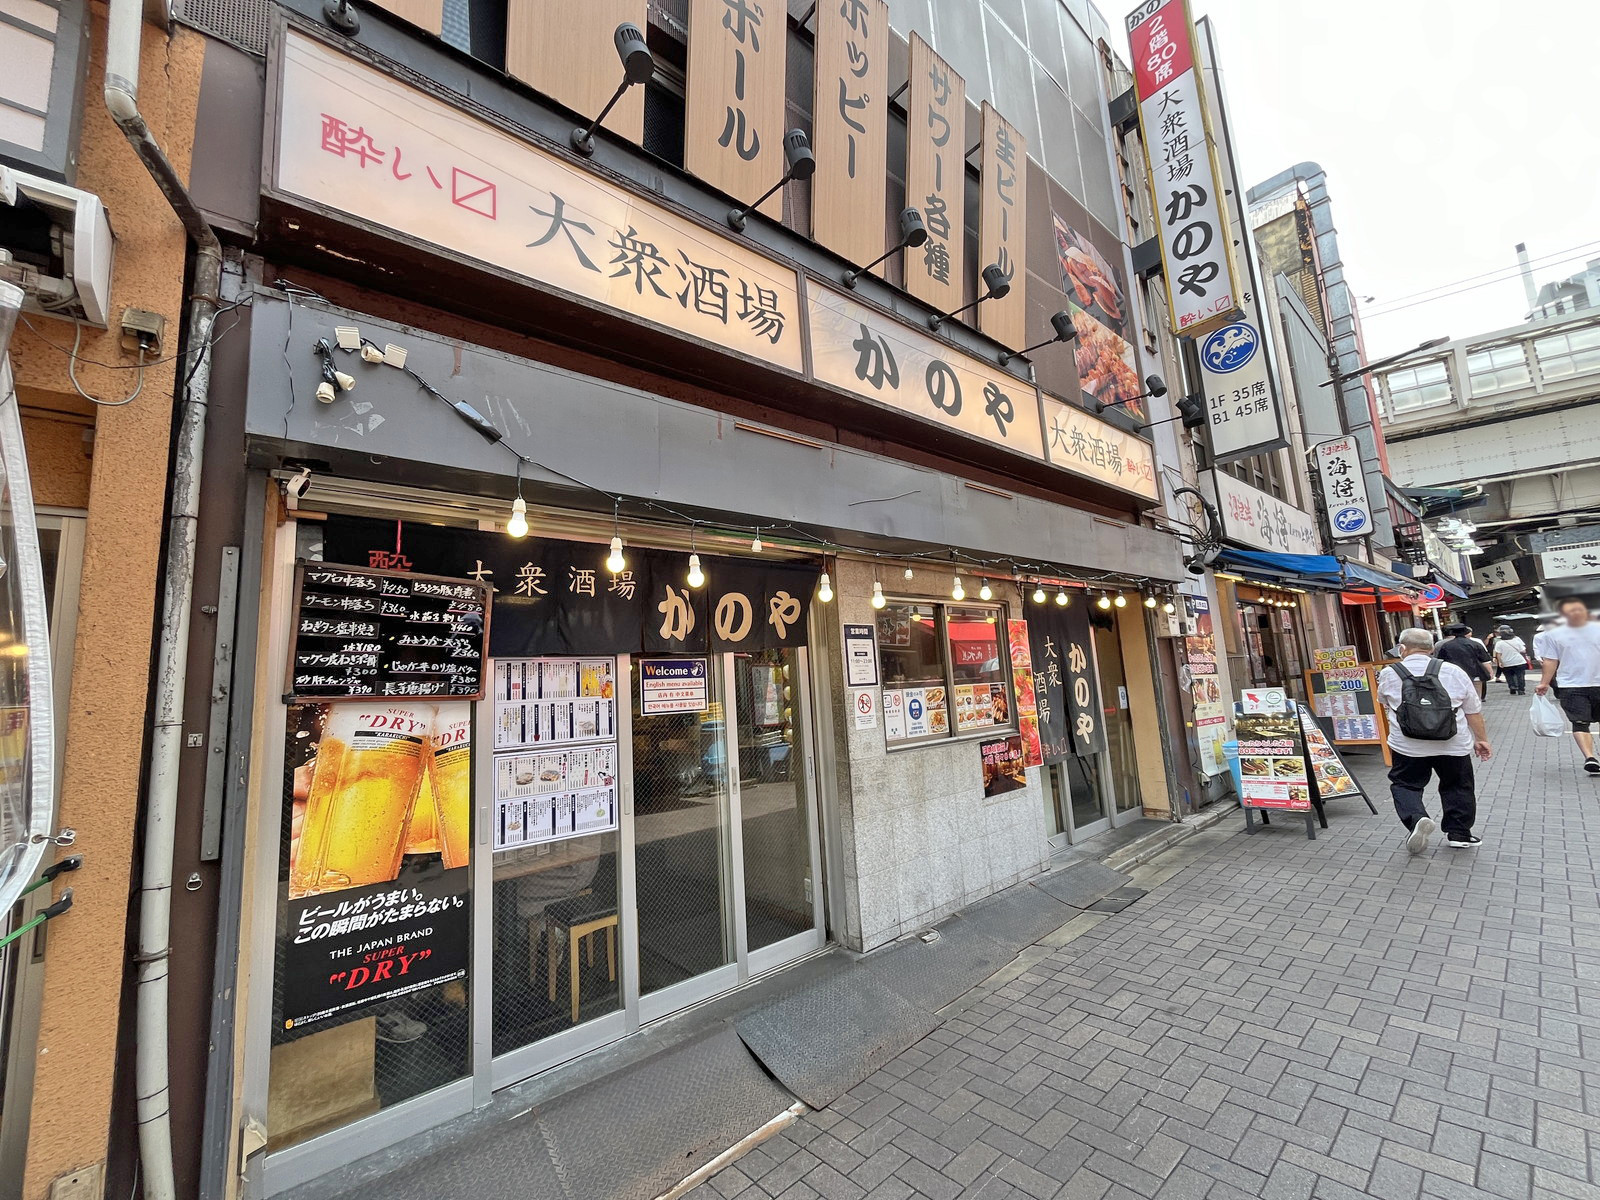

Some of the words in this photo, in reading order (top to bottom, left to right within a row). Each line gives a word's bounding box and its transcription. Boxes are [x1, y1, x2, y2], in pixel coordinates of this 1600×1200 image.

[1146, 14, 1177, 86] 2階80席
[718, 0, 764, 161] ボール
[1157, 88, 1194, 183] 大衆酒場
[924, 62, 952, 287] サワー各種
[1165, 184, 1220, 298] かのや
[526, 191, 786, 345] 大衆酒場
[852, 323, 1015, 437] かのや
[1210, 394, 1226, 410] 1F
[1232, 380, 1266, 402] 35席
[1212, 410, 1231, 425] B1
[1235, 397, 1269, 417] 45席
[1050, 416, 1122, 477] 大衆酒場
[1327, 456, 1356, 498] 海将
[308, 572, 377, 591] マグロ中落ち
[382, 579, 409, 594] ¥450
[304, 595, 376, 611] サーモン中落ち
[381, 601, 406, 614] ¥360
[466, 560, 637, 601] 大衆酒場
[658, 585, 801, 642] かのや
[450, 623, 473, 632] ¥460
[451, 648, 480, 657] ¥360
[345, 667, 378, 676] ¥300
[450, 674, 477, 684] ¥380
[645, 665, 688, 676] Welcome
[1340, 679, 1362, 691] 300
[348, 685, 372, 695] ¥390
[1068, 642, 1094, 744] かのや
[386, 707, 415, 719] SUPER
[293, 896, 464, 945] この瞬間がたまらない。
[299, 887, 423, 926] ビールがうまい。
[329, 948, 353, 960] THE
[356, 936, 393, 954] JAPAN
[396, 927, 433, 942] BRAND
[362, 945, 405, 964] SUPER
